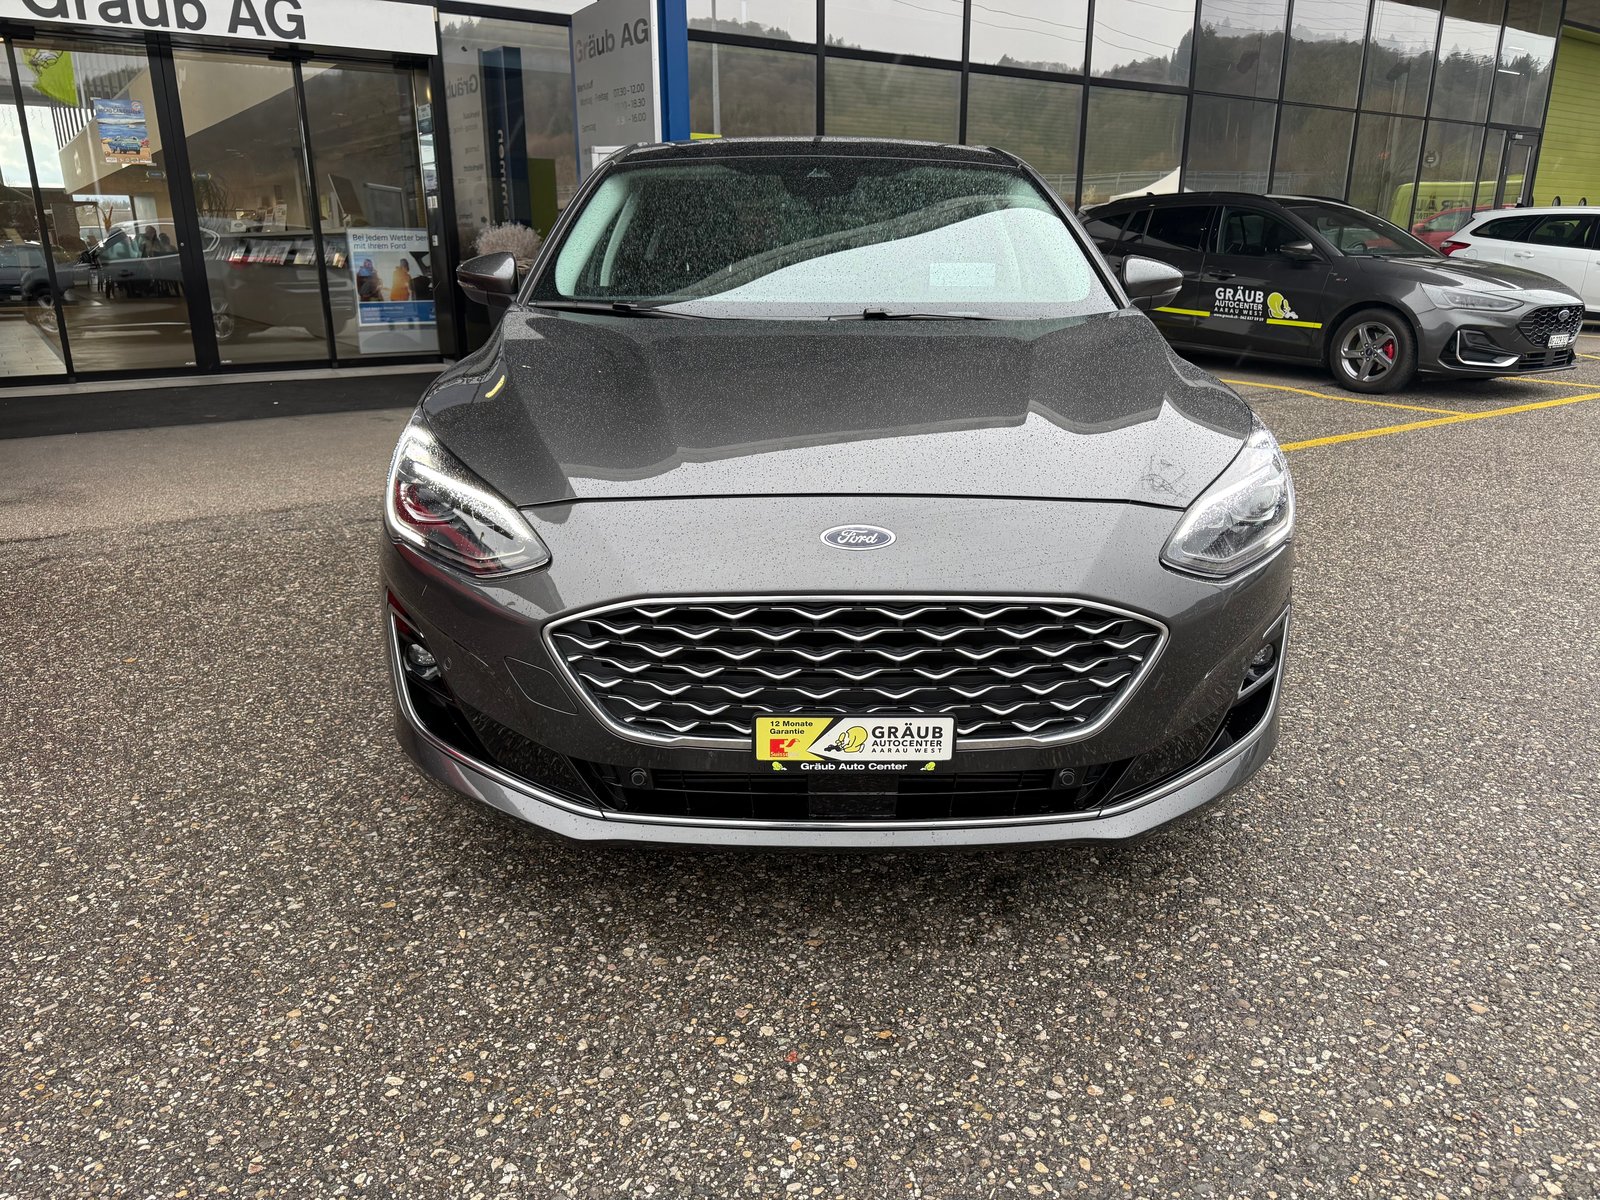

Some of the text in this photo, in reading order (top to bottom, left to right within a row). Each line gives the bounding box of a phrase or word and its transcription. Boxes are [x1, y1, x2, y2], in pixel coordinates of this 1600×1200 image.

[227, 0, 307, 40] AG
[576, 18, 649, 63] Gräub AG
[366, 234, 388, 243] jedem
[1215, 286, 1264, 303] GRÄUB
[1214, 300, 1263, 310] AUTOCENTER
[837, 529, 878, 544] Ford
[871, 722, 943, 739] GRÄUB
[872, 739, 942, 747] AUTOCENTER
[800, 762, 908, 771] Gräub Auto Center
